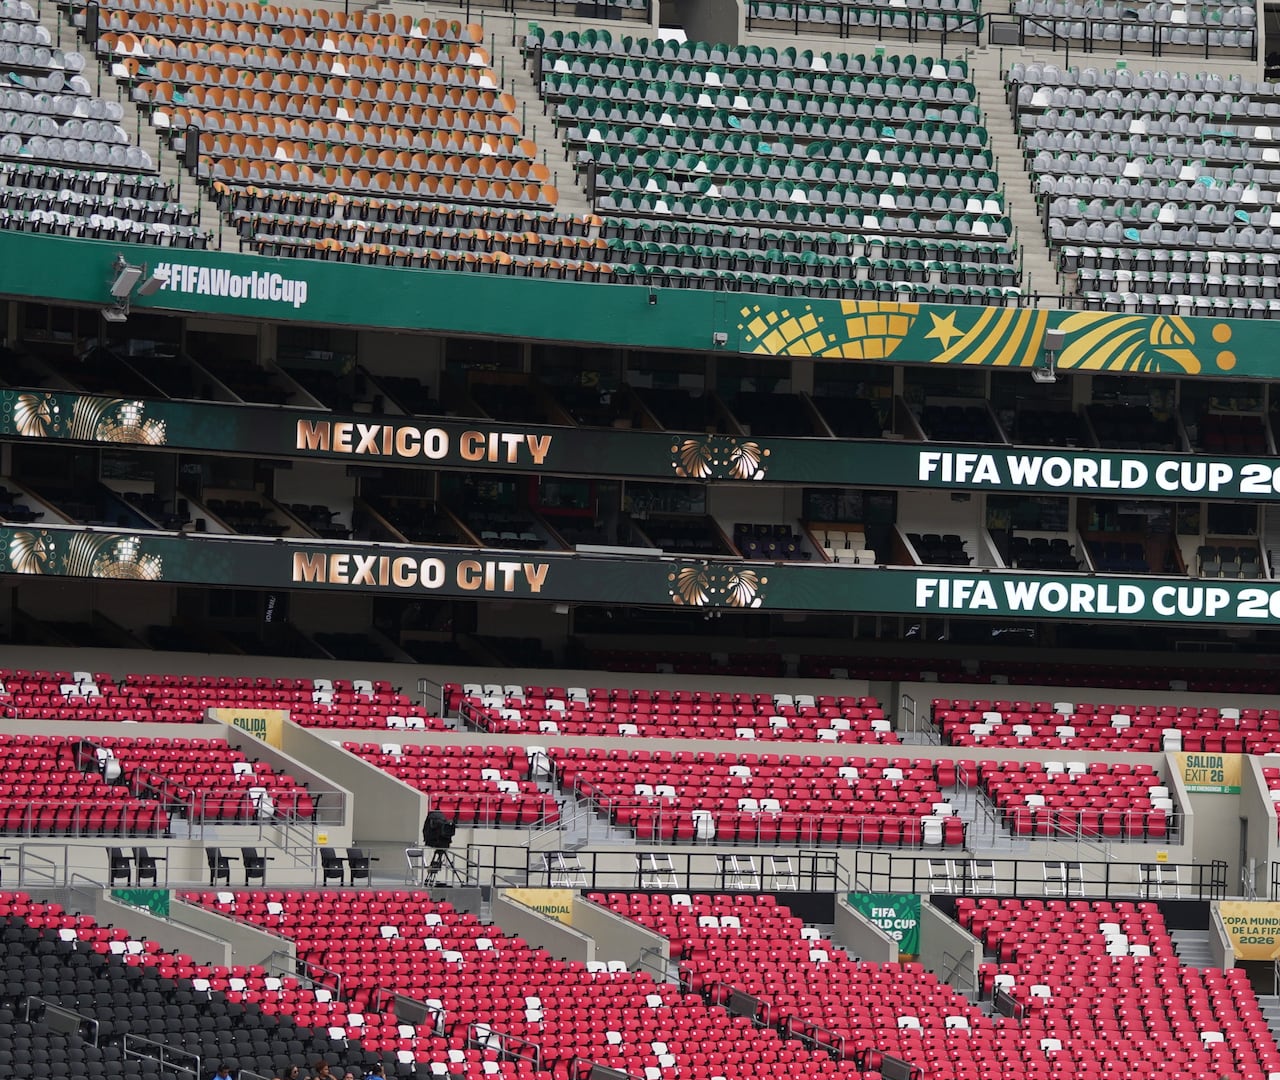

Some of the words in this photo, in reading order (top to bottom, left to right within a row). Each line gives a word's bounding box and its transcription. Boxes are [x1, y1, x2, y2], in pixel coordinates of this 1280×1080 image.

[154, 262, 308, 308] #FIFAWorldCup
[297, 419, 449, 459] MEXICO
[460, 431, 552, 465] CITY
[918, 451, 1001, 484] FIFA
[1006, 455, 1148, 489] WORLD
[1155, 460, 1233, 492] CUP
[292, 551, 446, 589] MEXICO
[456, 559, 549, 593] CITY
[915, 578, 998, 609] FIFA
[1003, 580, 1147, 614] WORLD
[1152, 585, 1230, 617] CUP
[233, 718, 267, 732] SALIDA
[1186, 755, 1223, 769] SALIDA
[1185, 769, 1208, 782] EXIT
[1210, 769, 1224, 782] 26
[871, 908, 897, 918] FIFA
[894, 919, 917, 929] CUP
[1232, 926, 1245, 934] DE
[1246, 926, 1260, 935] LA
[1239, 936, 1275, 945] 2026
